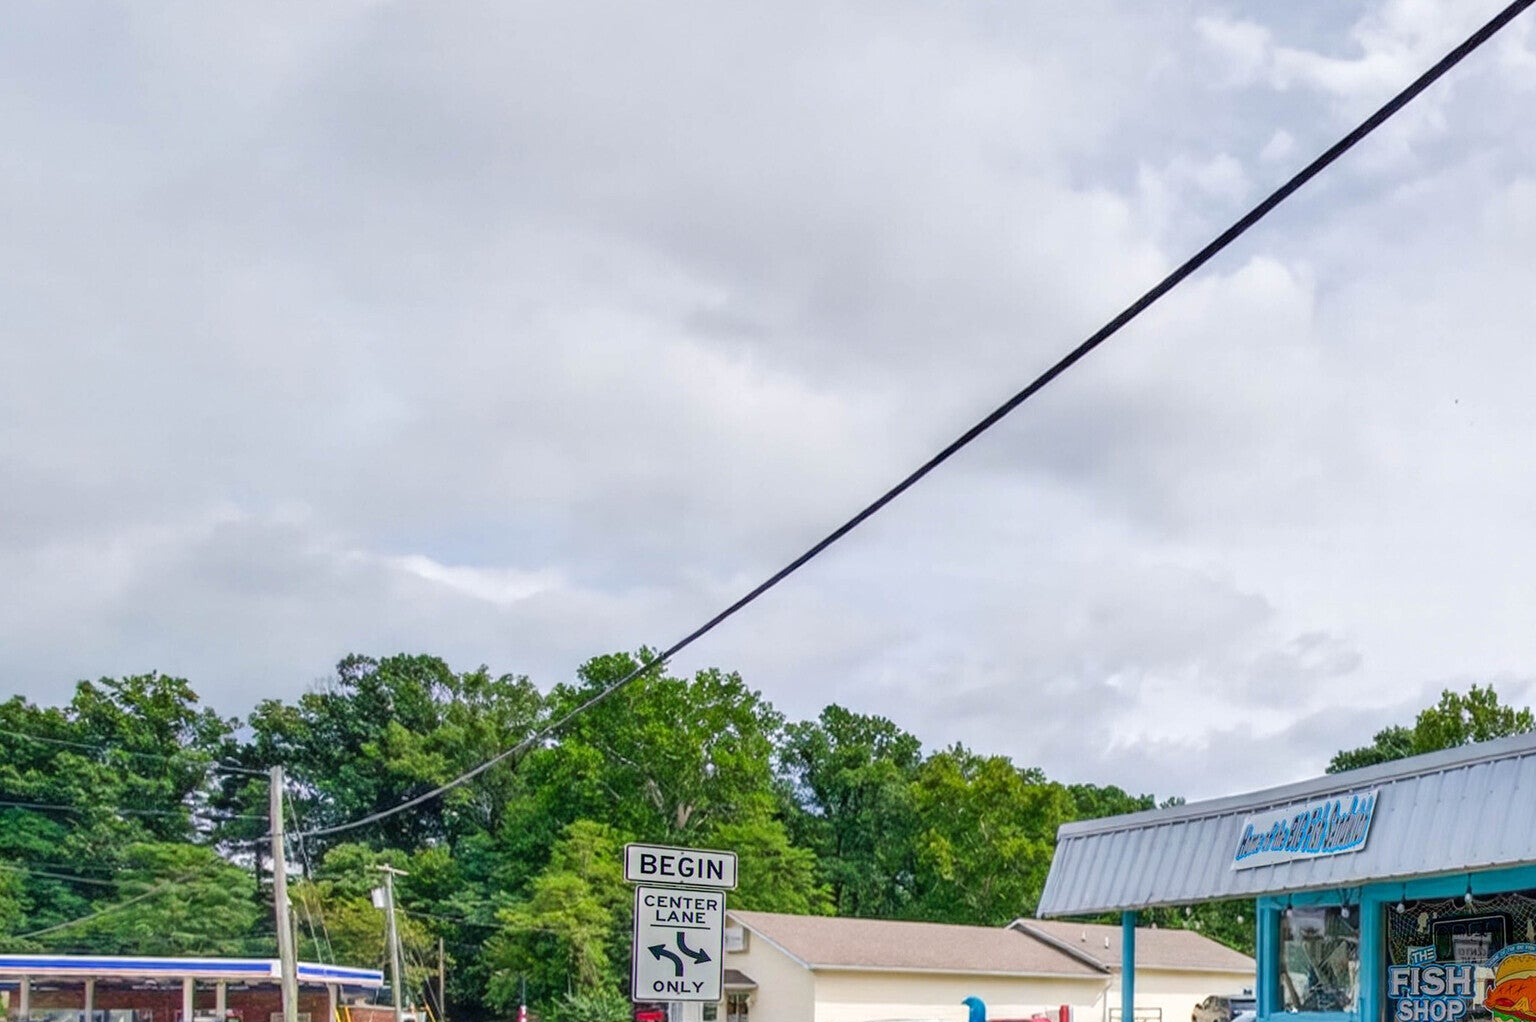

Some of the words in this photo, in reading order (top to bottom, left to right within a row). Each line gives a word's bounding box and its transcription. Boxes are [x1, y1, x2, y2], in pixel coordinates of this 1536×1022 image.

[640, 853, 723, 880] BEGIN
[644, 895, 718, 911] CENTER
[656, 910, 706, 924] LANE
[1412, 947, 1435, 964] THE
[653, 981, 704, 993] ONLY
[1390, 966, 1472, 996] FISH
[1398, 999, 1464, 1022] SHOP
